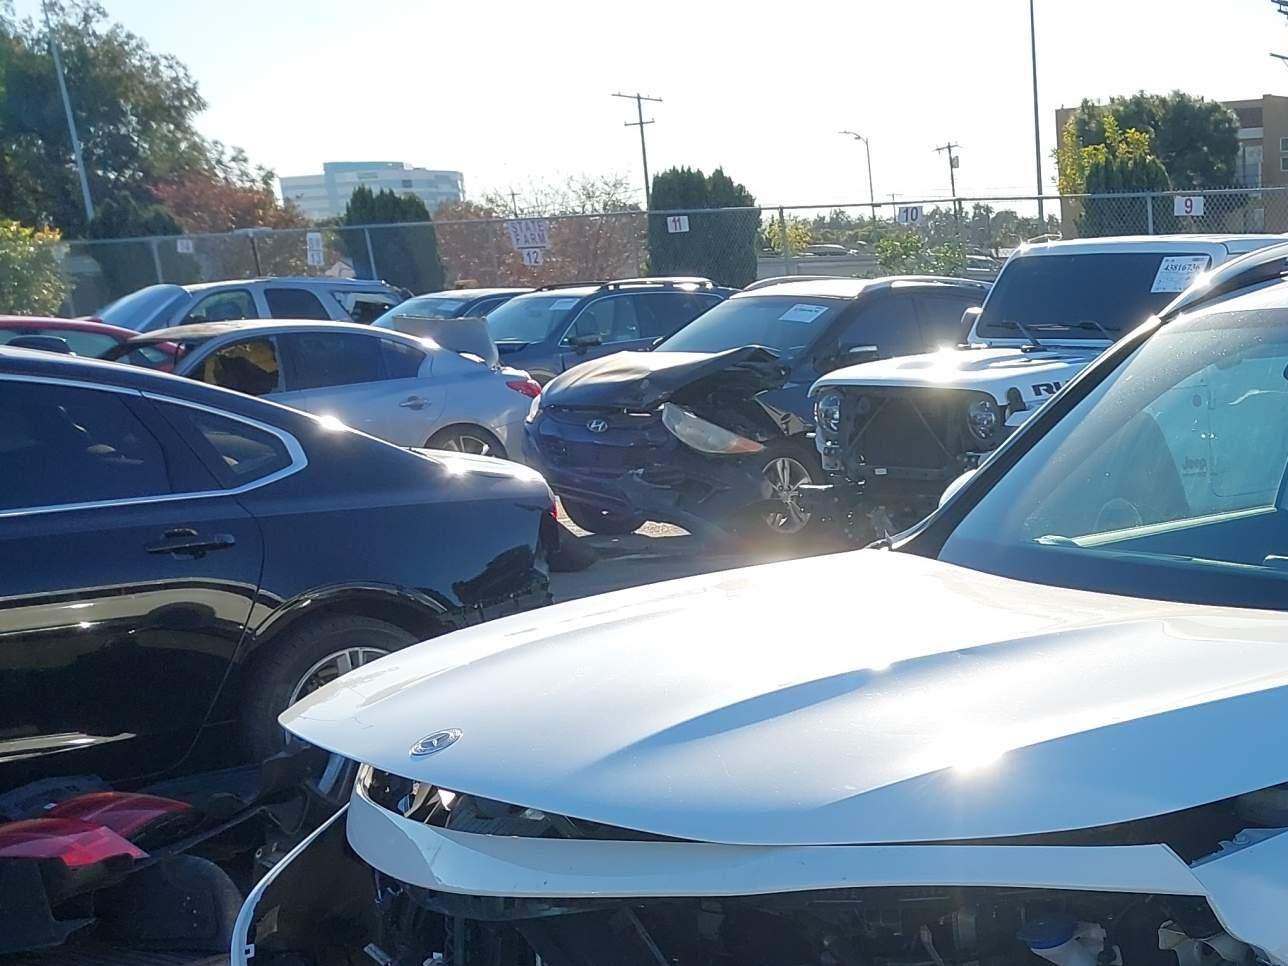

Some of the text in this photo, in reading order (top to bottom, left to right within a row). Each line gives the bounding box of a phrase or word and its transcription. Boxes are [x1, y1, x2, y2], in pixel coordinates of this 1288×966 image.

[1184, 198, 1193, 214] 9
[903, 206, 919, 222] 10
[511, 221, 545, 233] STATE
[672, 217, 682, 231] 11
[515, 232, 545, 246] FARM
[526, 250, 540, 264] 12
